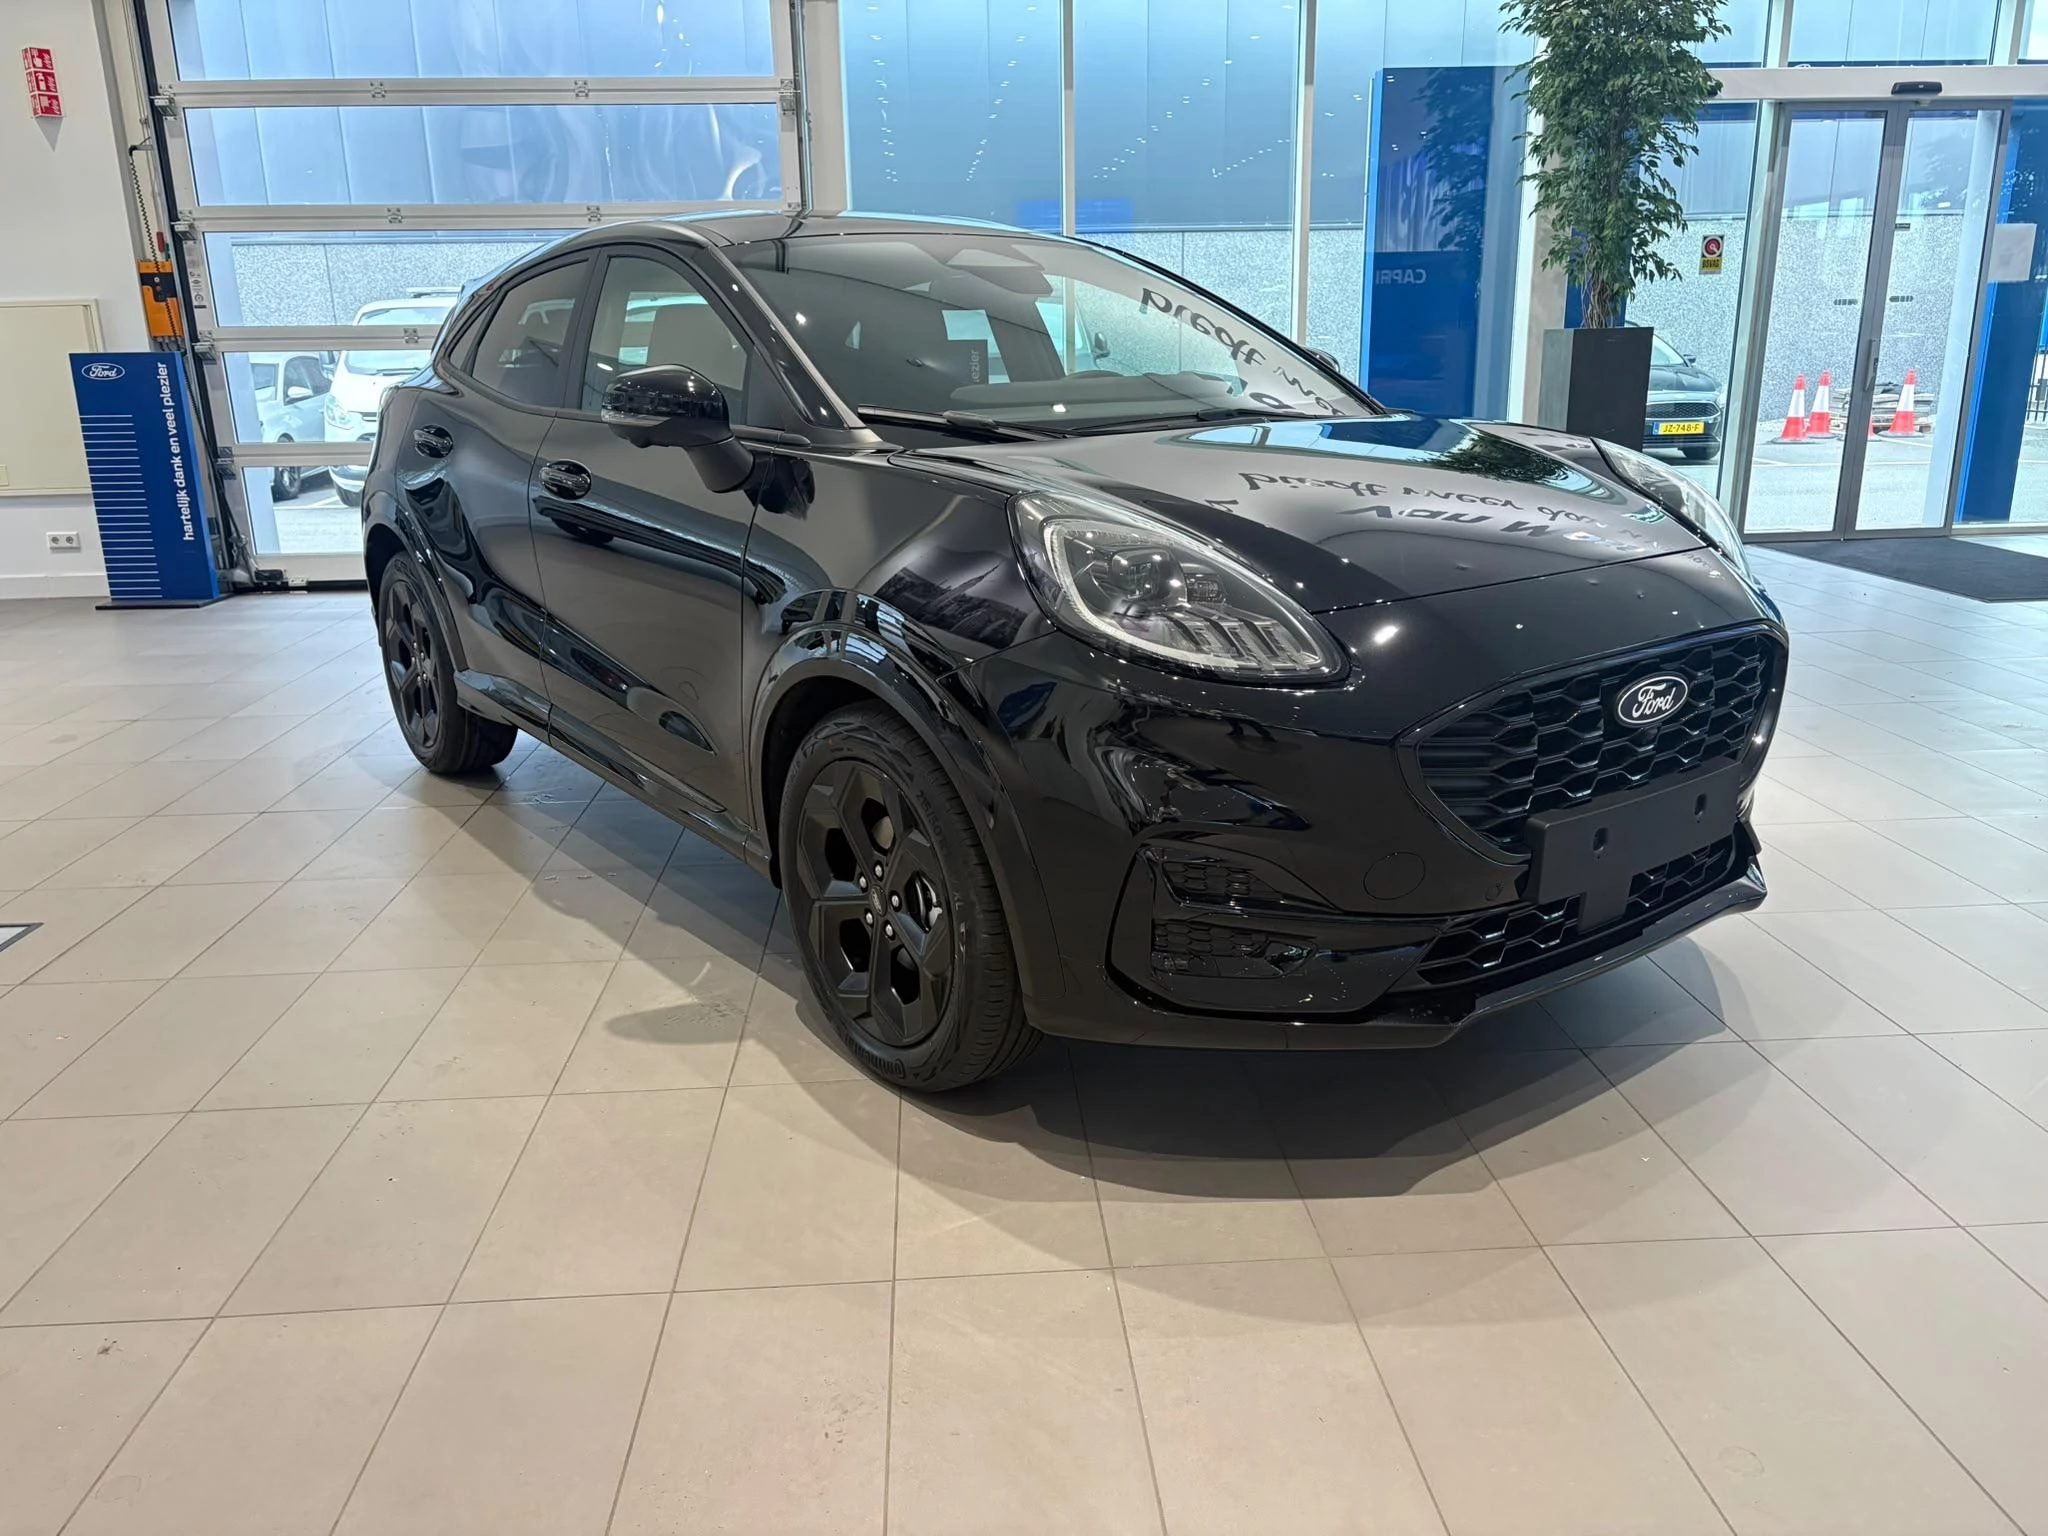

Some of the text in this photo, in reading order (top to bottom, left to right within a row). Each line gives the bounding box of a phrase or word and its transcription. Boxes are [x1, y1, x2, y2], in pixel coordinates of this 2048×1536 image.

[89, 365, 117, 378] Ford
[156, 362, 195, 540] hartelijk dank en veel plezier
[1632, 683, 1676, 718] Ford
